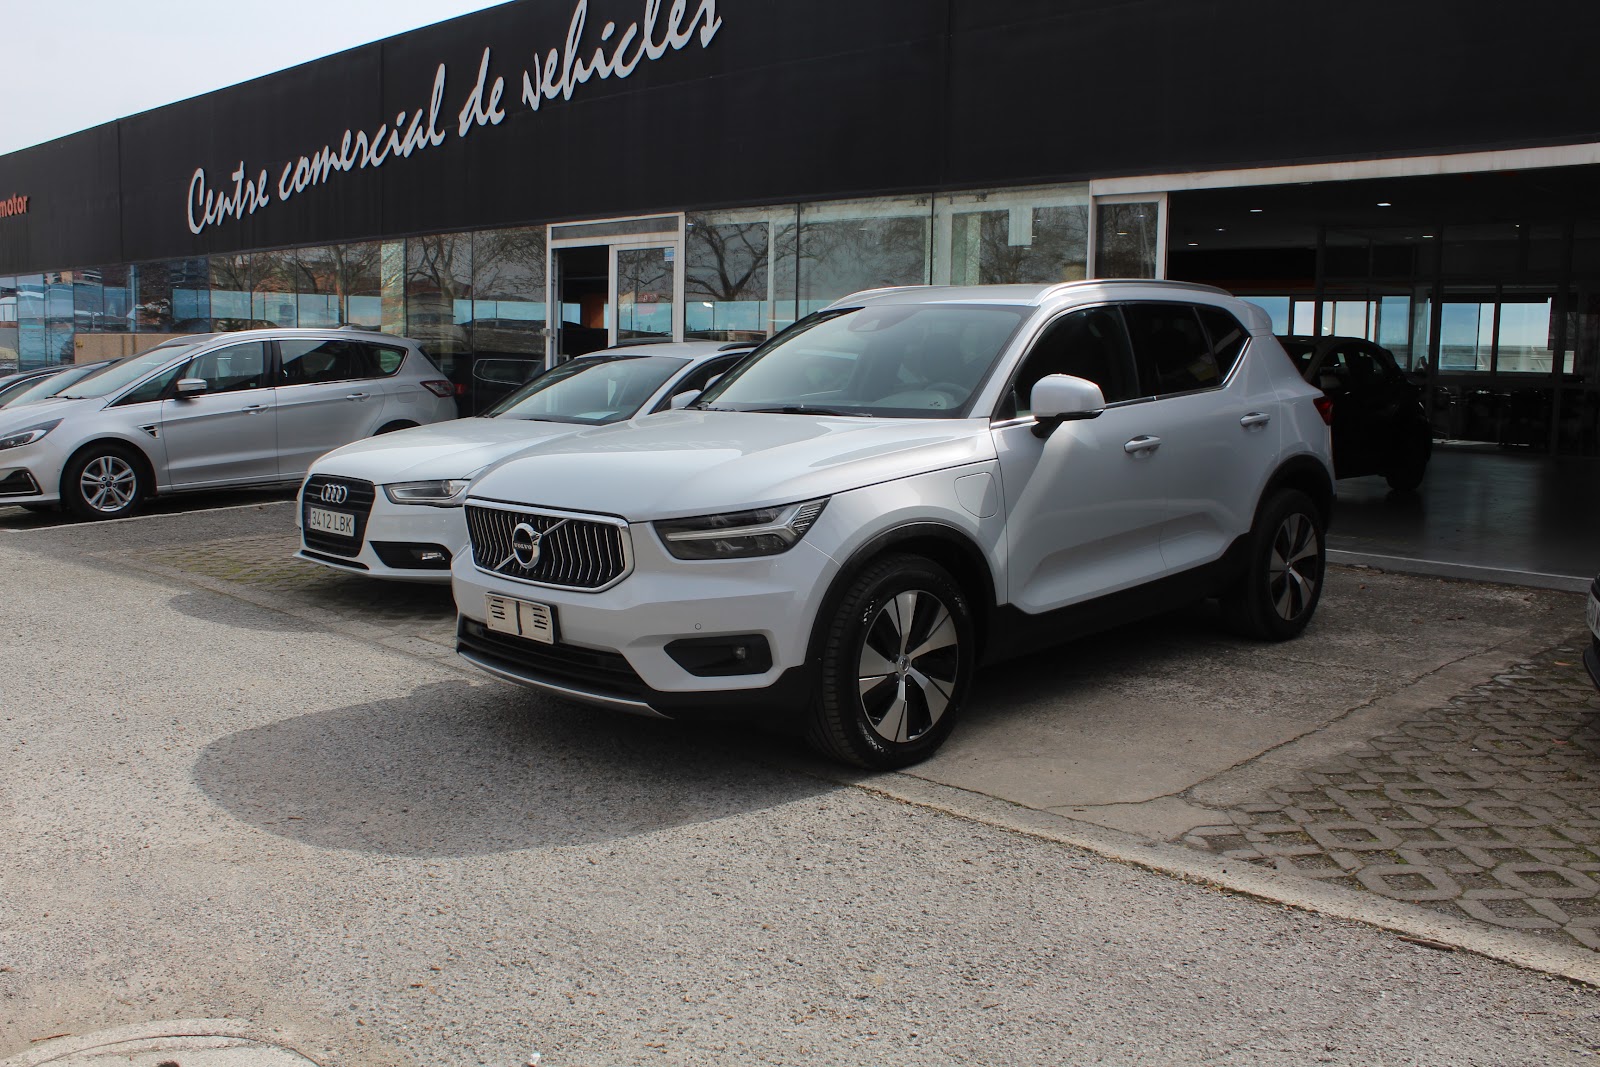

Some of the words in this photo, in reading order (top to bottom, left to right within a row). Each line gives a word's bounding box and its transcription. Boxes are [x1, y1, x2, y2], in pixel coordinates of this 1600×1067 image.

[188, 160, 269, 234] Centre
[279, 63, 446, 200] comercial
[459, 46, 505, 137] de
[522, 0, 722, 111] vehicles
[312, 510, 332, 529] 3412
[334, 514, 352, 533] LBK
[513, 542, 533, 550] VOLVO
